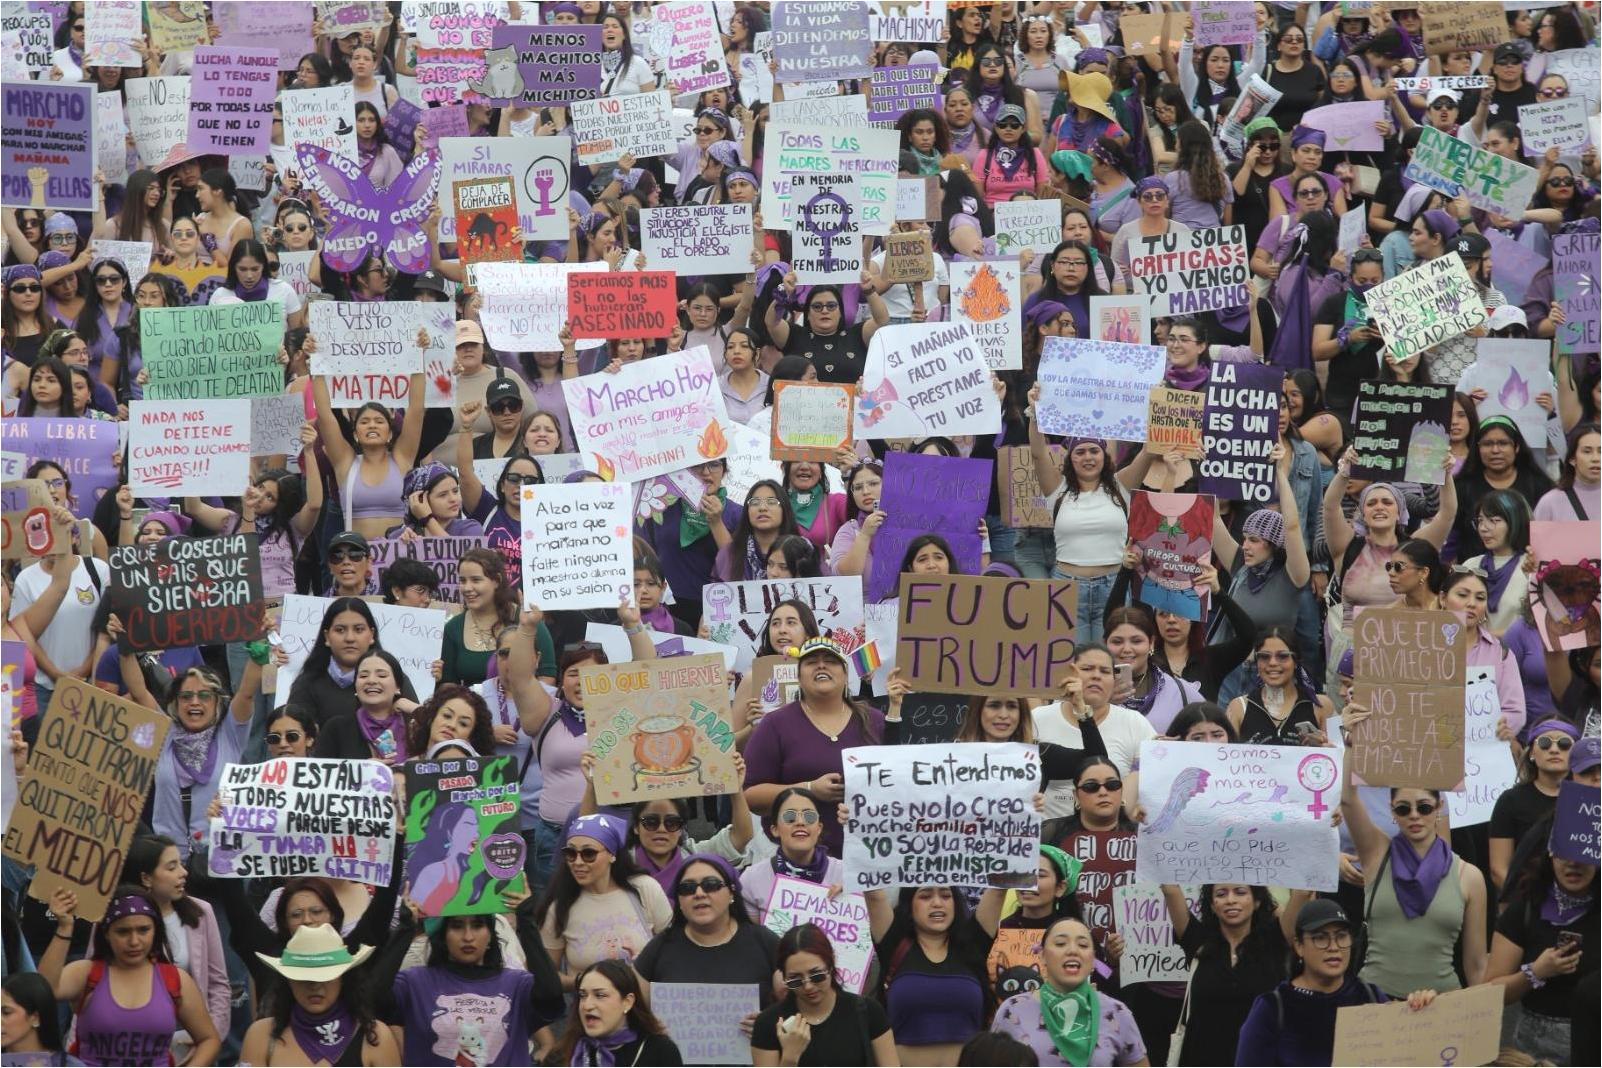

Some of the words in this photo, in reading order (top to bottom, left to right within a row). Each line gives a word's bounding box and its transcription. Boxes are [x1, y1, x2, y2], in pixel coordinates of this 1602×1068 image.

[777, 29, 868, 45] DEFENDEMOS
[878, 17, 944, 41] MACHISMO
[529, 34, 585, 46] MENOS
[195, 54, 231, 65] LUCHA
[236, 56, 278, 67] AUNQUE
[522, 53, 600, 64] MACHITOS
[702, 59, 719, 75] NO
[781, 55, 862, 71] NUESTRA
[203, 71, 219, 81] LO
[225, 72, 271, 82] TENGAS
[913, 69, 930, 79] SOY
[1402, 79, 1416, 88] YO
[217, 87, 252, 97] TODO
[523, 90, 596, 102] MICHITOS
[903, 83, 935, 95] QUIERO
[6, 88, 85, 121] MARCHO
[190, 102, 212, 112] POR
[215, 102, 250, 112] TODAS
[254, 103, 274, 113] LAS
[573, 102, 594, 117] HOY
[599, 100, 620, 115] NO
[27, 118, 56, 129] HOY
[197, 119, 221, 130] QUE
[225, 119, 241, 130] NO
[247, 119, 260, 130] LO
[574, 118, 604, 130] TODAS
[608, 111, 649, 125] NUESTRAS
[210, 135, 255, 147] TIENEN
[574, 129, 603, 142] VOCES
[646, 130, 673, 143] PUEDE
[778, 131, 823, 149] TODAS
[832, 136, 860, 150] LAS
[37, 141, 86, 152] MARCHAR
[472, 146, 491, 160] SI
[327, 155, 362, 182] NOS
[406, 152, 430, 178] NOS
[453, 162, 512, 174] MIRARAS
[779, 155, 831, 171] MADRES
[840, 159, 897, 173] MERECIMOS
[1, 178, 31, 198] POR
[48, 177, 92, 199] ELLAS
[298, 152, 380, 223] SEMBRARON
[792, 176, 804, 186] EN
[810, 175, 853, 185] MEMORIA
[460, 195, 510, 208] COMPLACER
[461, 188, 488, 200] DEJA
[665, 207, 690, 218] ERES
[694, 206, 728, 217] NEUTRAL
[733, 205, 746, 214] EN
[797, 203, 853, 215] MAESTRAS
[714, 216, 725, 226] DE
[796, 221, 859, 232] MEXICANAS
[325, 232, 377, 253] MIEDO
[386, 233, 427, 253] ALAS
[693, 237, 720, 247] LADO
[1142, 233, 1177, 254] TU
[1191, 225, 1242, 248] SOLO
[793, 259, 859, 271] FEMINICIDIO
[1132, 245, 1232, 277] CRITICAS
[1405, 271, 1424, 284] VA
[1430, 257, 1454, 275] MAL
[1141, 274, 1167, 294] YO
[1179, 265, 1246, 289] VENGO
[1169, 284, 1249, 313] MARCHO
[144, 311, 160, 337] SE
[168, 311, 186, 335] TE
[192, 309, 224, 332] PONE
[230, 302, 280, 327] GRANDE
[218, 330, 262, 353] ACOSAS
[1388, 309, 1485, 358] VIOLADORES
[887, 351, 904, 368] SI
[911, 325, 969, 358] MAÑANA
[147, 359, 183, 381] PERO
[187, 354, 217, 376] BIEN
[908, 357, 947, 384] FALTO
[954, 347, 974, 364] YO
[1211, 362, 1236, 383] LA
[225, 370, 281, 396] DELATAN
[908, 368, 984, 410] PRESTAME
[1166, 391, 1199, 405] DICEN
[1207, 386, 1278, 410] LUCHA
[142, 411, 177, 425] NADA
[183, 410, 204, 422] NOS
[925, 411, 947, 429] TU
[955, 397, 984, 419] VOZ
[1152, 415, 1174, 427] HASTA
[1209, 413, 1234, 431] ES
[1243, 414, 1268, 433] UN
[46, 424, 97, 439] LIBRE
[164, 425, 233, 439] DETIENE
[133, 446, 190, 459] CUANDO
[194, 441, 250, 455] LUCHAMOS
[1204, 436, 1274, 457] POEMA
[1200, 459, 1273, 482] COLECTI
[1241, 482, 1271, 501] VO
[536, 500, 572, 517] Alzo
[545, 521, 578, 535] para
[583, 519, 607, 533] que
[168, 534, 247, 560] COSECHA
[535, 536, 588, 552] mañana
[528, 557, 562, 572] falte
[564, 553, 618, 569] ninguna
[121, 569, 150, 589] UN
[206, 557, 248, 579] QUE
[148, 580, 251, 614] SIEMBRA
[905, 581, 1075, 631] FUCK
[1361, 618, 1410, 645] QUE
[1413, 619, 1443, 651] EL
[901, 637, 1076, 688] TRUMP
[1359, 647, 1458, 682] PRIVILEGIO
[585, 675, 611, 695] LO
[616, 672, 650, 693] QUE
[658, 664, 722, 690] HIERVE
[1370, 688, 1397, 716] NO
[1407, 690, 1437, 716] TE
[84, 697, 129, 742] NOS
[689, 700, 736, 753] TAPA
[591, 730, 618, 760] NO
[612, 707, 635, 735] SE
[45, 717, 155, 796] QUITARON
[228, 765, 261, 783] HOY
[261, 761, 287, 785] NO
[292, 760, 362, 792] ESTÁN
[1215, 778, 1279, 789] marea
[27, 751, 78, 785] TANTO
[78, 772, 100, 797] QUE
[101, 783, 140, 825] NOS
[20, 779, 127, 847] QUITARON
[231, 787, 287, 809] TODAS
[295, 792, 393, 819] NUESTRAS
[482, 802, 515, 816] FUTURO
[851, 793, 904, 818] Pues
[946, 794, 966, 819] lo
[222, 806, 278, 829] VOCES
[348, 818, 390, 839] DESDE
[256, 835, 326, 855] TUMBA
[332, 835, 357, 855] NO
[862, 837, 893, 859] YO
[4, 827, 24, 856] EL
[21, 820, 121, 896] MIEDO
[237, 855, 265, 876] SE
[269, 855, 319, 875] PUEDE
[325, 857, 390, 884] GRITAR
[898, 866, 947, 885] lucha
